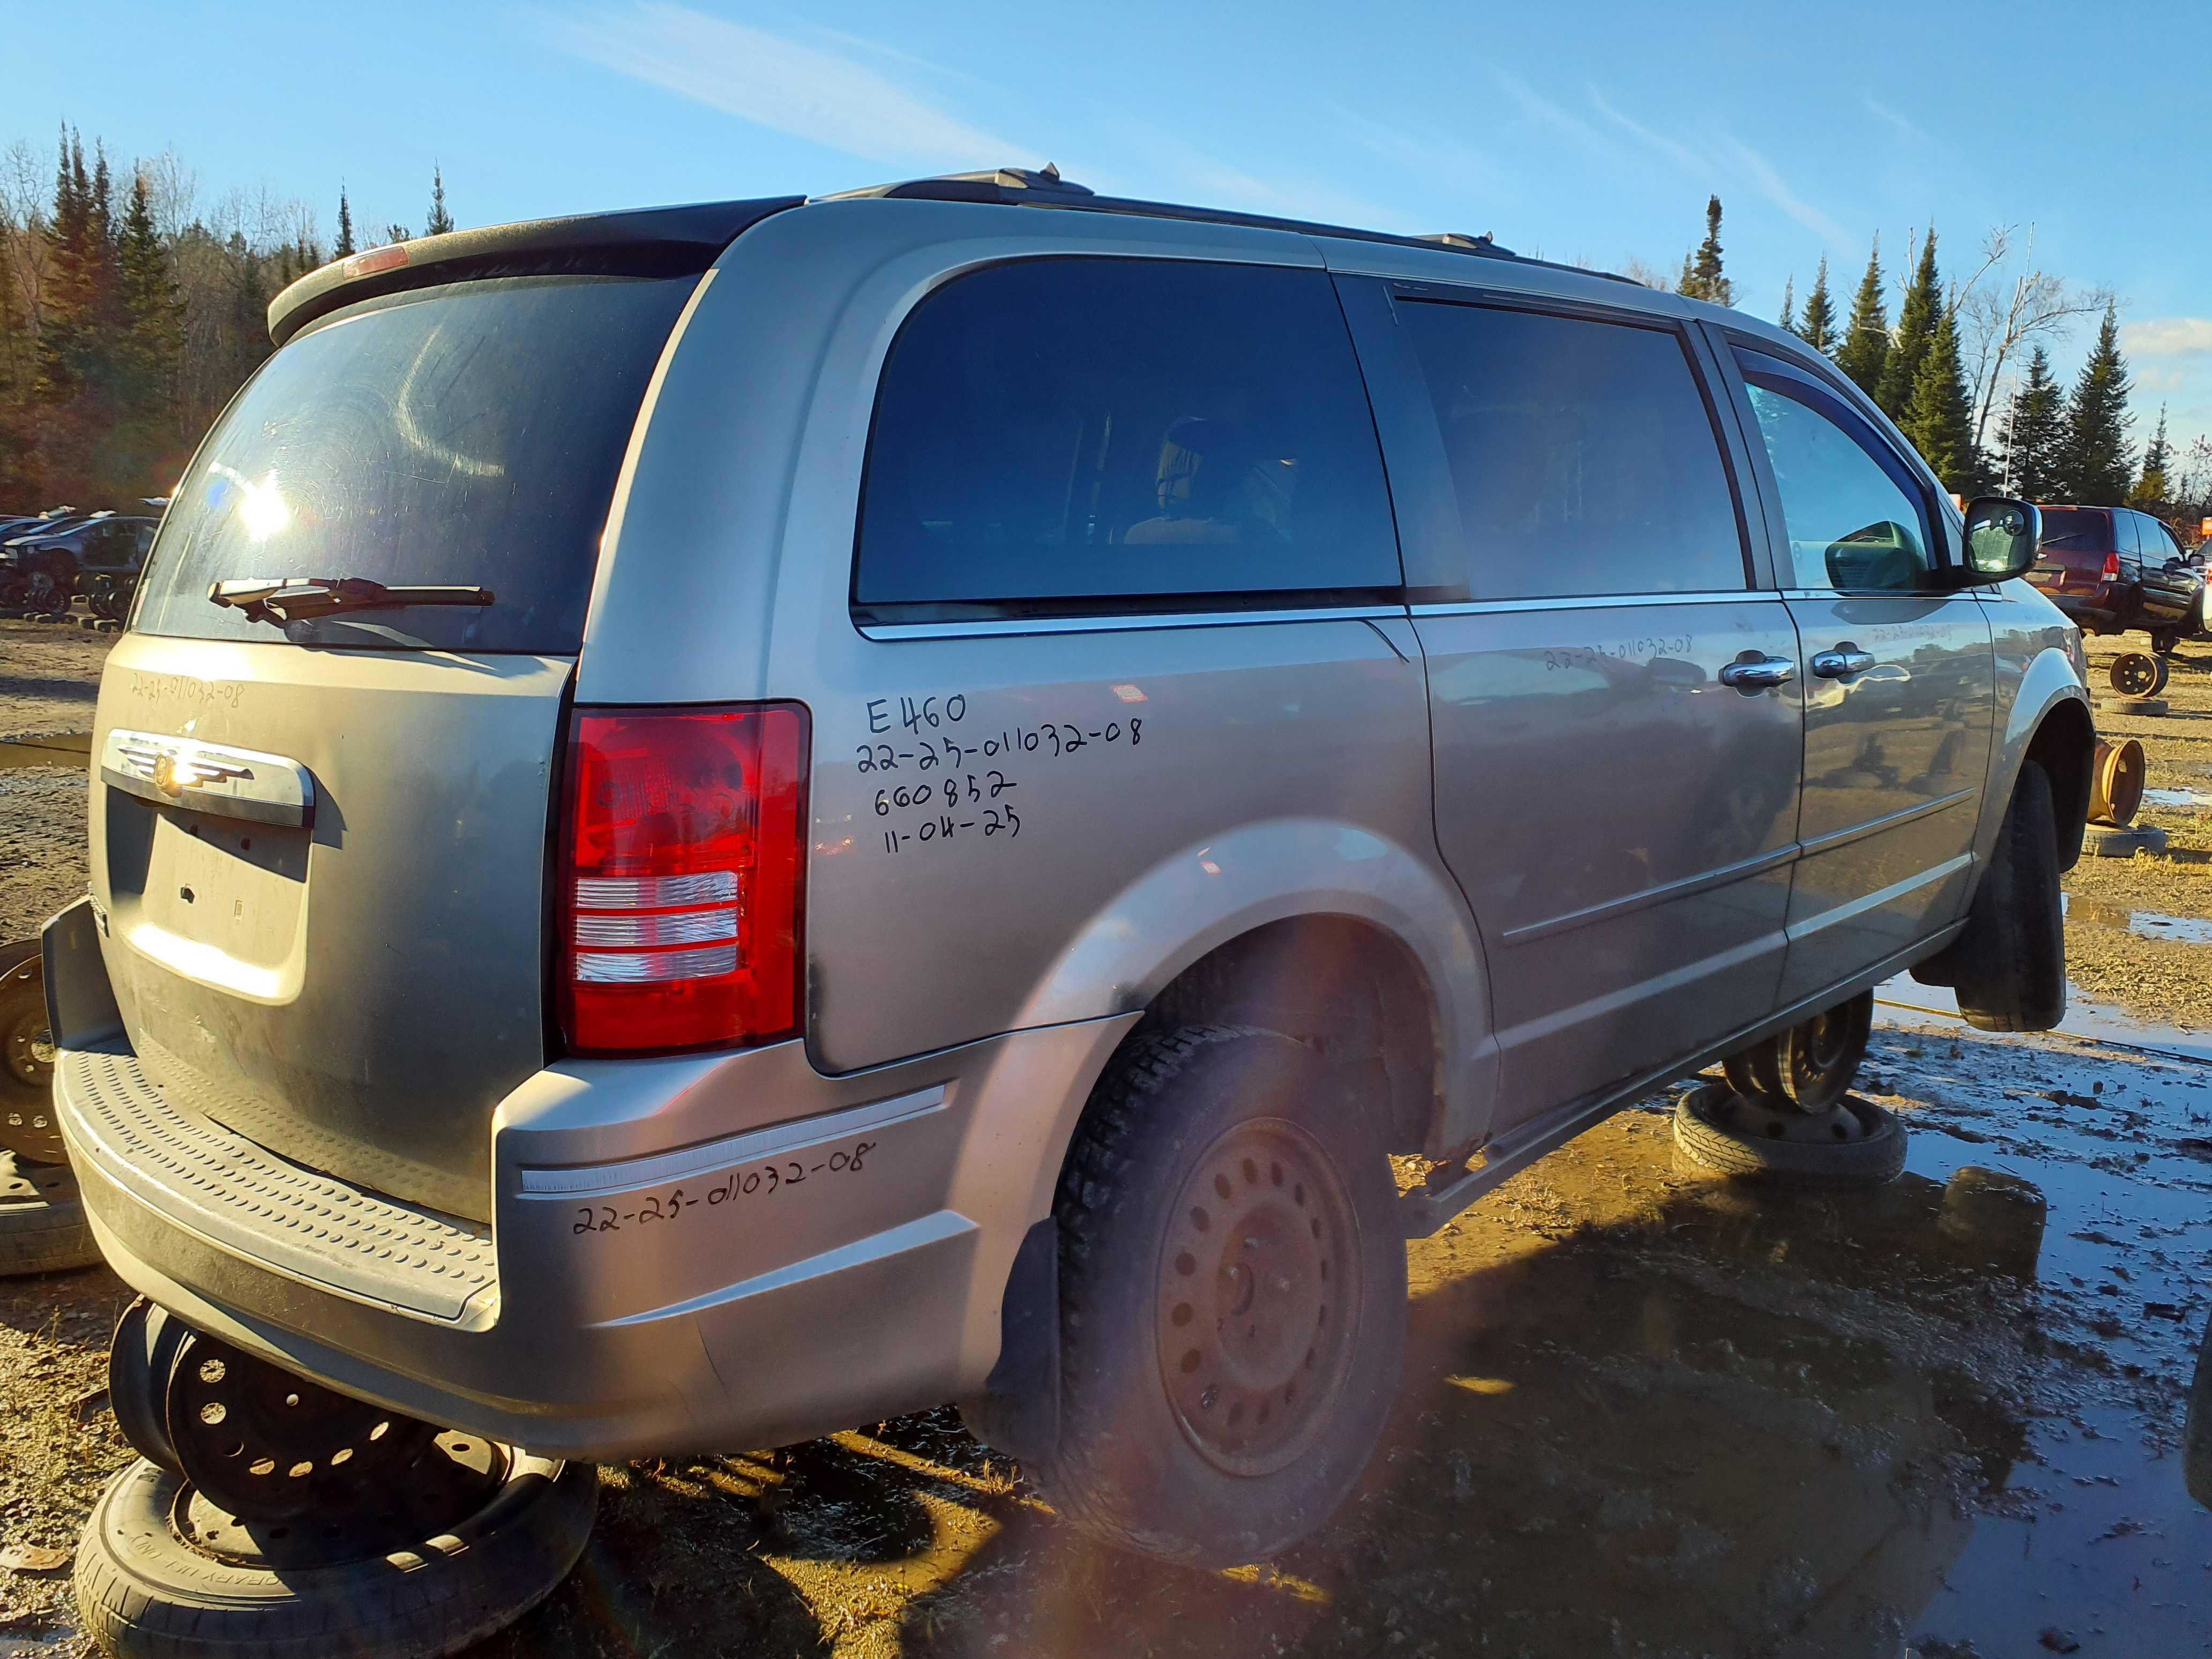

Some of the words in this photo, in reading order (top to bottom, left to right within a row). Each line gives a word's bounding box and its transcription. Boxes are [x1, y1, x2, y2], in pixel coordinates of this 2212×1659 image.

[857, 718, 1142, 773] 22-25-011032-08
[884, 804, 1021, 854] 11-04-25
[572, 1142, 876, 1234] 22-25-011032-08
[201, 1572, 280, 1586] ORARY
